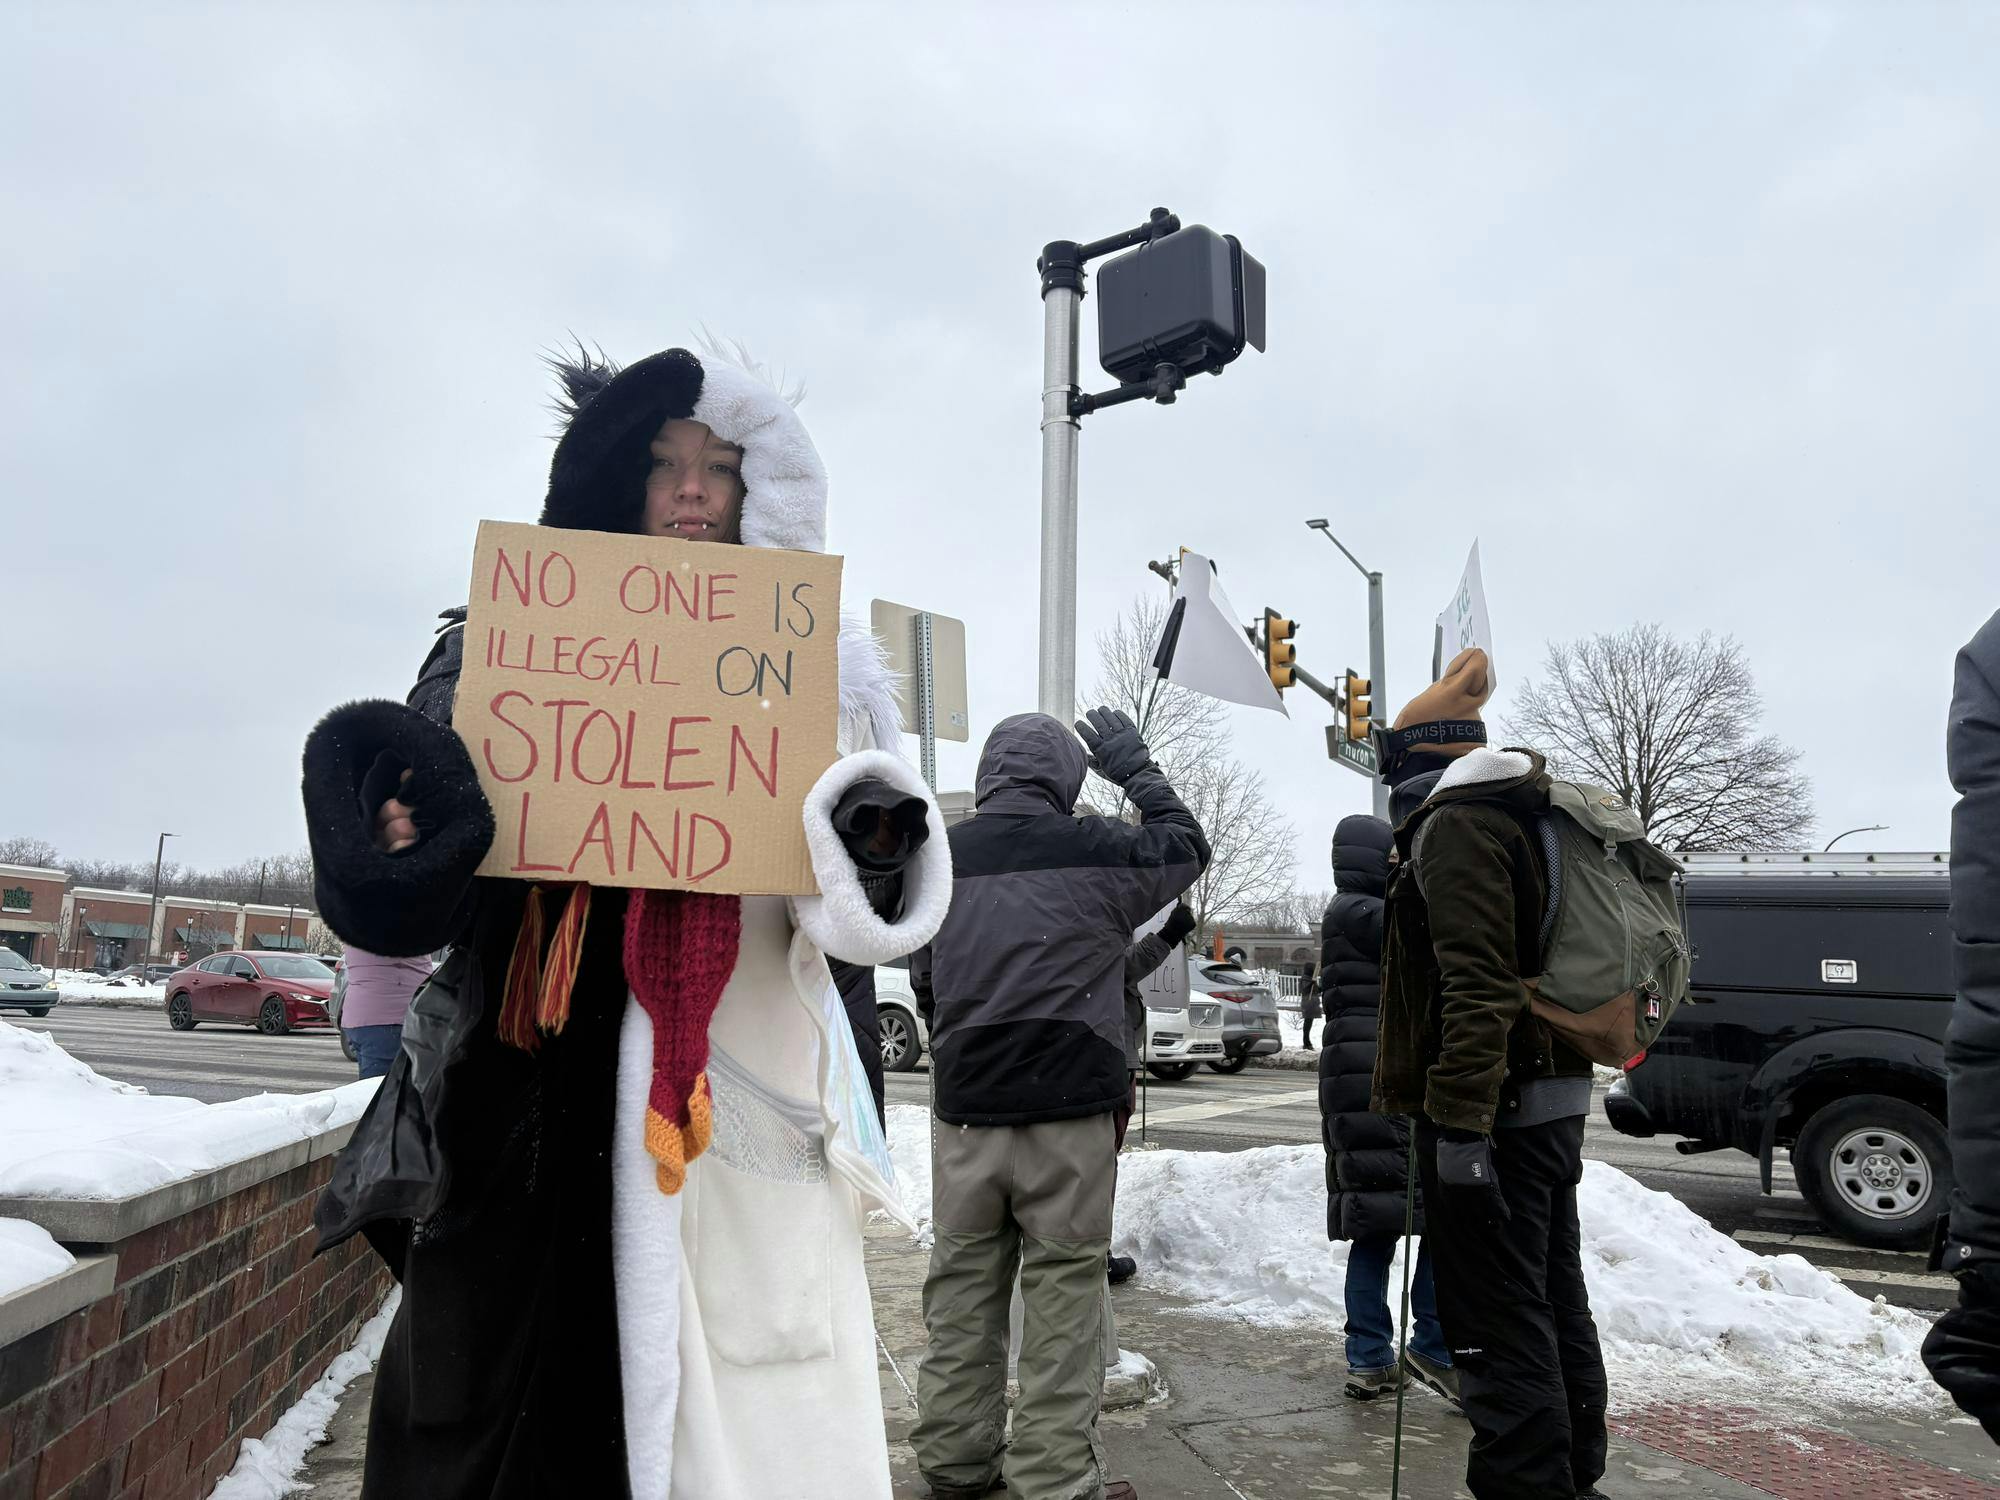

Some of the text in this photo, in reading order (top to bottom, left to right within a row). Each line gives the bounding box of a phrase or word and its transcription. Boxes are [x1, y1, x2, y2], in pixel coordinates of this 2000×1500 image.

[492, 548, 815, 638] NO ONE IS
[486, 626, 793, 696] ILLEGAL ON
[483, 690, 779, 798] STOLEN
[1403, 724, 1480, 742] SWISSTECH
[510, 791, 732, 883] LAND
[1149, 965, 1177, 994] ICE
